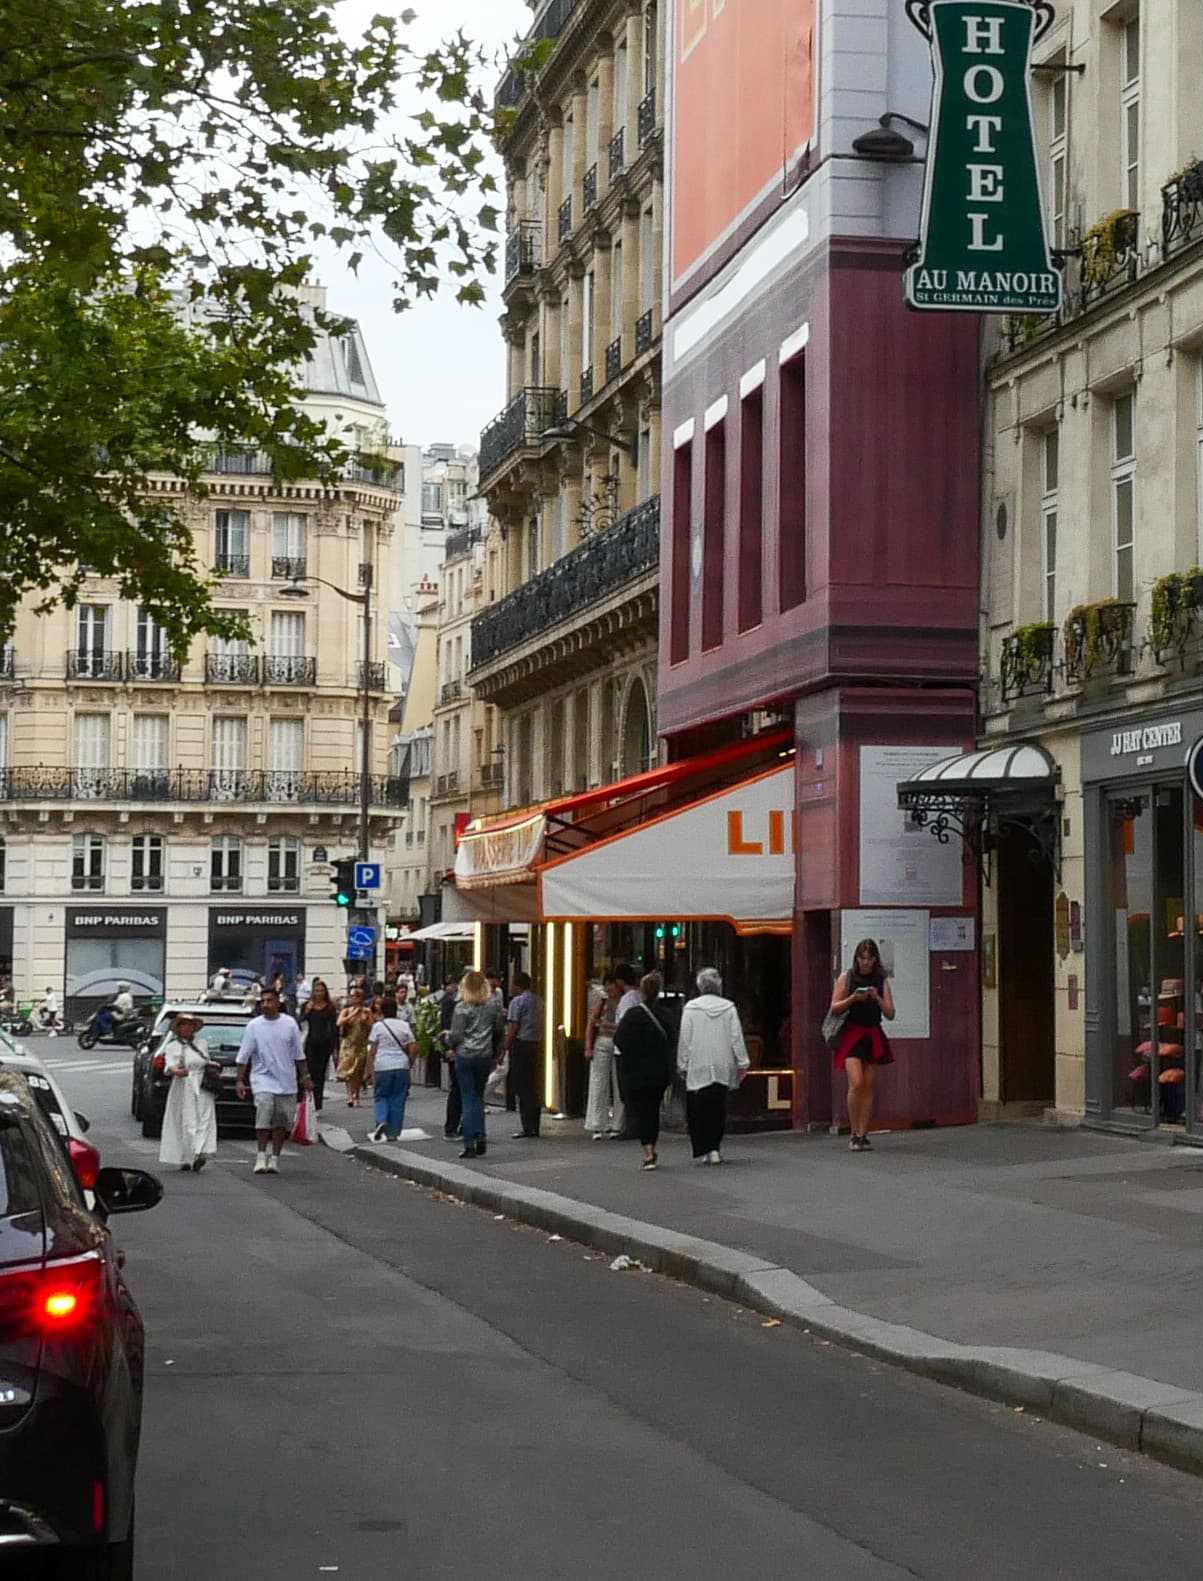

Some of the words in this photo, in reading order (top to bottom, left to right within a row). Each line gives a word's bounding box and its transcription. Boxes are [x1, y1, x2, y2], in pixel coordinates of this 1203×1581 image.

[961, 15, 1005, 251] HOTEL
[916, 269, 948, 290] AU
[956, 271, 1057, 294] MANOIR
[933, 292, 999, 304] GERMAIN
[1003, 295, 1025, 305] des
[1122, 729, 1142, 753] HAT
[1142, 721, 1182, 750] CENTER
[728, 810, 798, 855] LI
[362, 867, 374, 885] P
[74, 916, 102, 926] BNP
[104, 916, 159, 926] PARIBAS
[216, 915, 244, 925] BNP
[245, 915, 299, 925] PARIBAS
